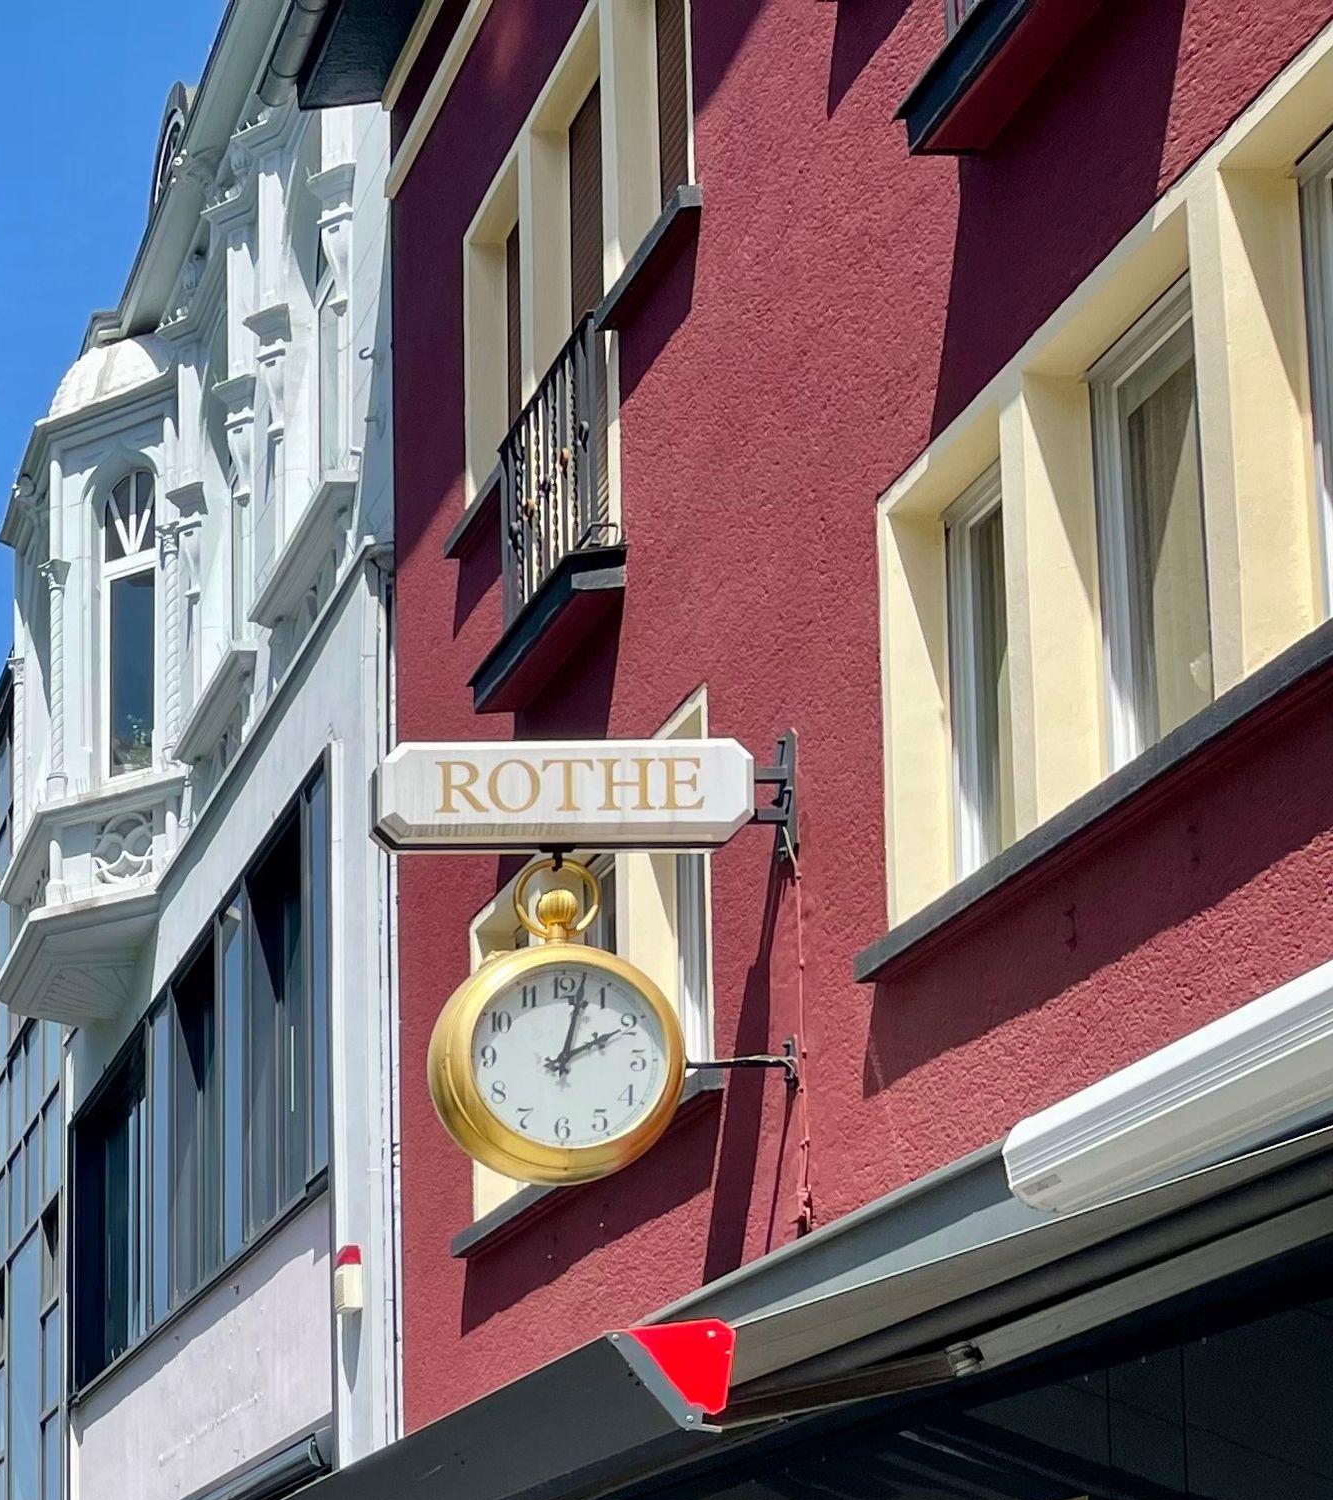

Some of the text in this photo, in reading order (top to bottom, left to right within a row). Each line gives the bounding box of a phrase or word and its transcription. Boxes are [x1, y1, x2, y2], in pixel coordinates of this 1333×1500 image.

[435, 758, 706, 813] ROTHE
[520, 984, 537, 1009] 11
[552, 975, 576, 1000] 12
[598, 986, 606, 1010] 1
[490, 1010, 512, 1033] 10
[620, 1012, 637, 1036] 2
[480, 1044, 497, 1068] 9
[490, 1080, 507, 1104] 8
[617, 1083, 634, 1107] 4
[516, 1107, 534, 1130] 7
[554, 1116, 571, 1140] 6
[591, 1108, 609, 1132] 5
